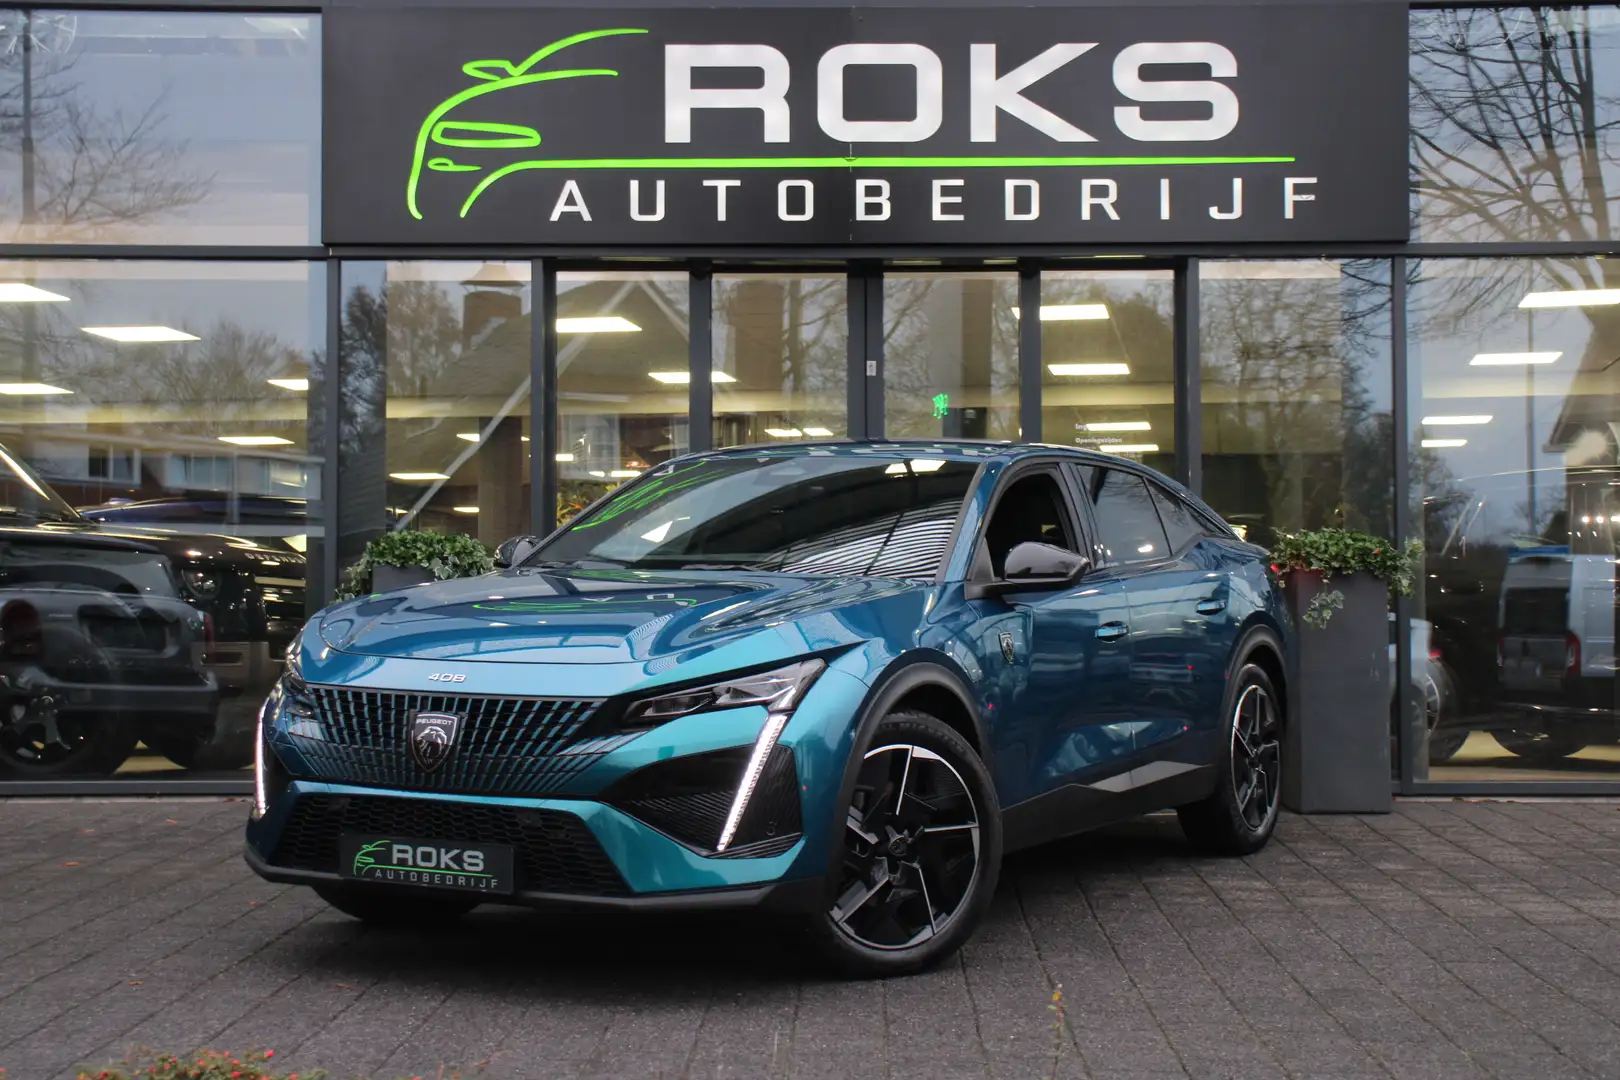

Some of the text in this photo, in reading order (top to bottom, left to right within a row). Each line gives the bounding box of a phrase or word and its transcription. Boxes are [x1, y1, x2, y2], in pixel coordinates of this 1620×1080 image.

[664, 42, 1239, 143] ROKS
[550, 177, 1318, 222] AUTOBEDRIJF
[428, 673, 466, 682] 408
[416, 718, 453, 726] PEUGEOT
[392, 844, 485, 872] ROKS
[375, 870, 499, 889] AUTOBEDRIJF
